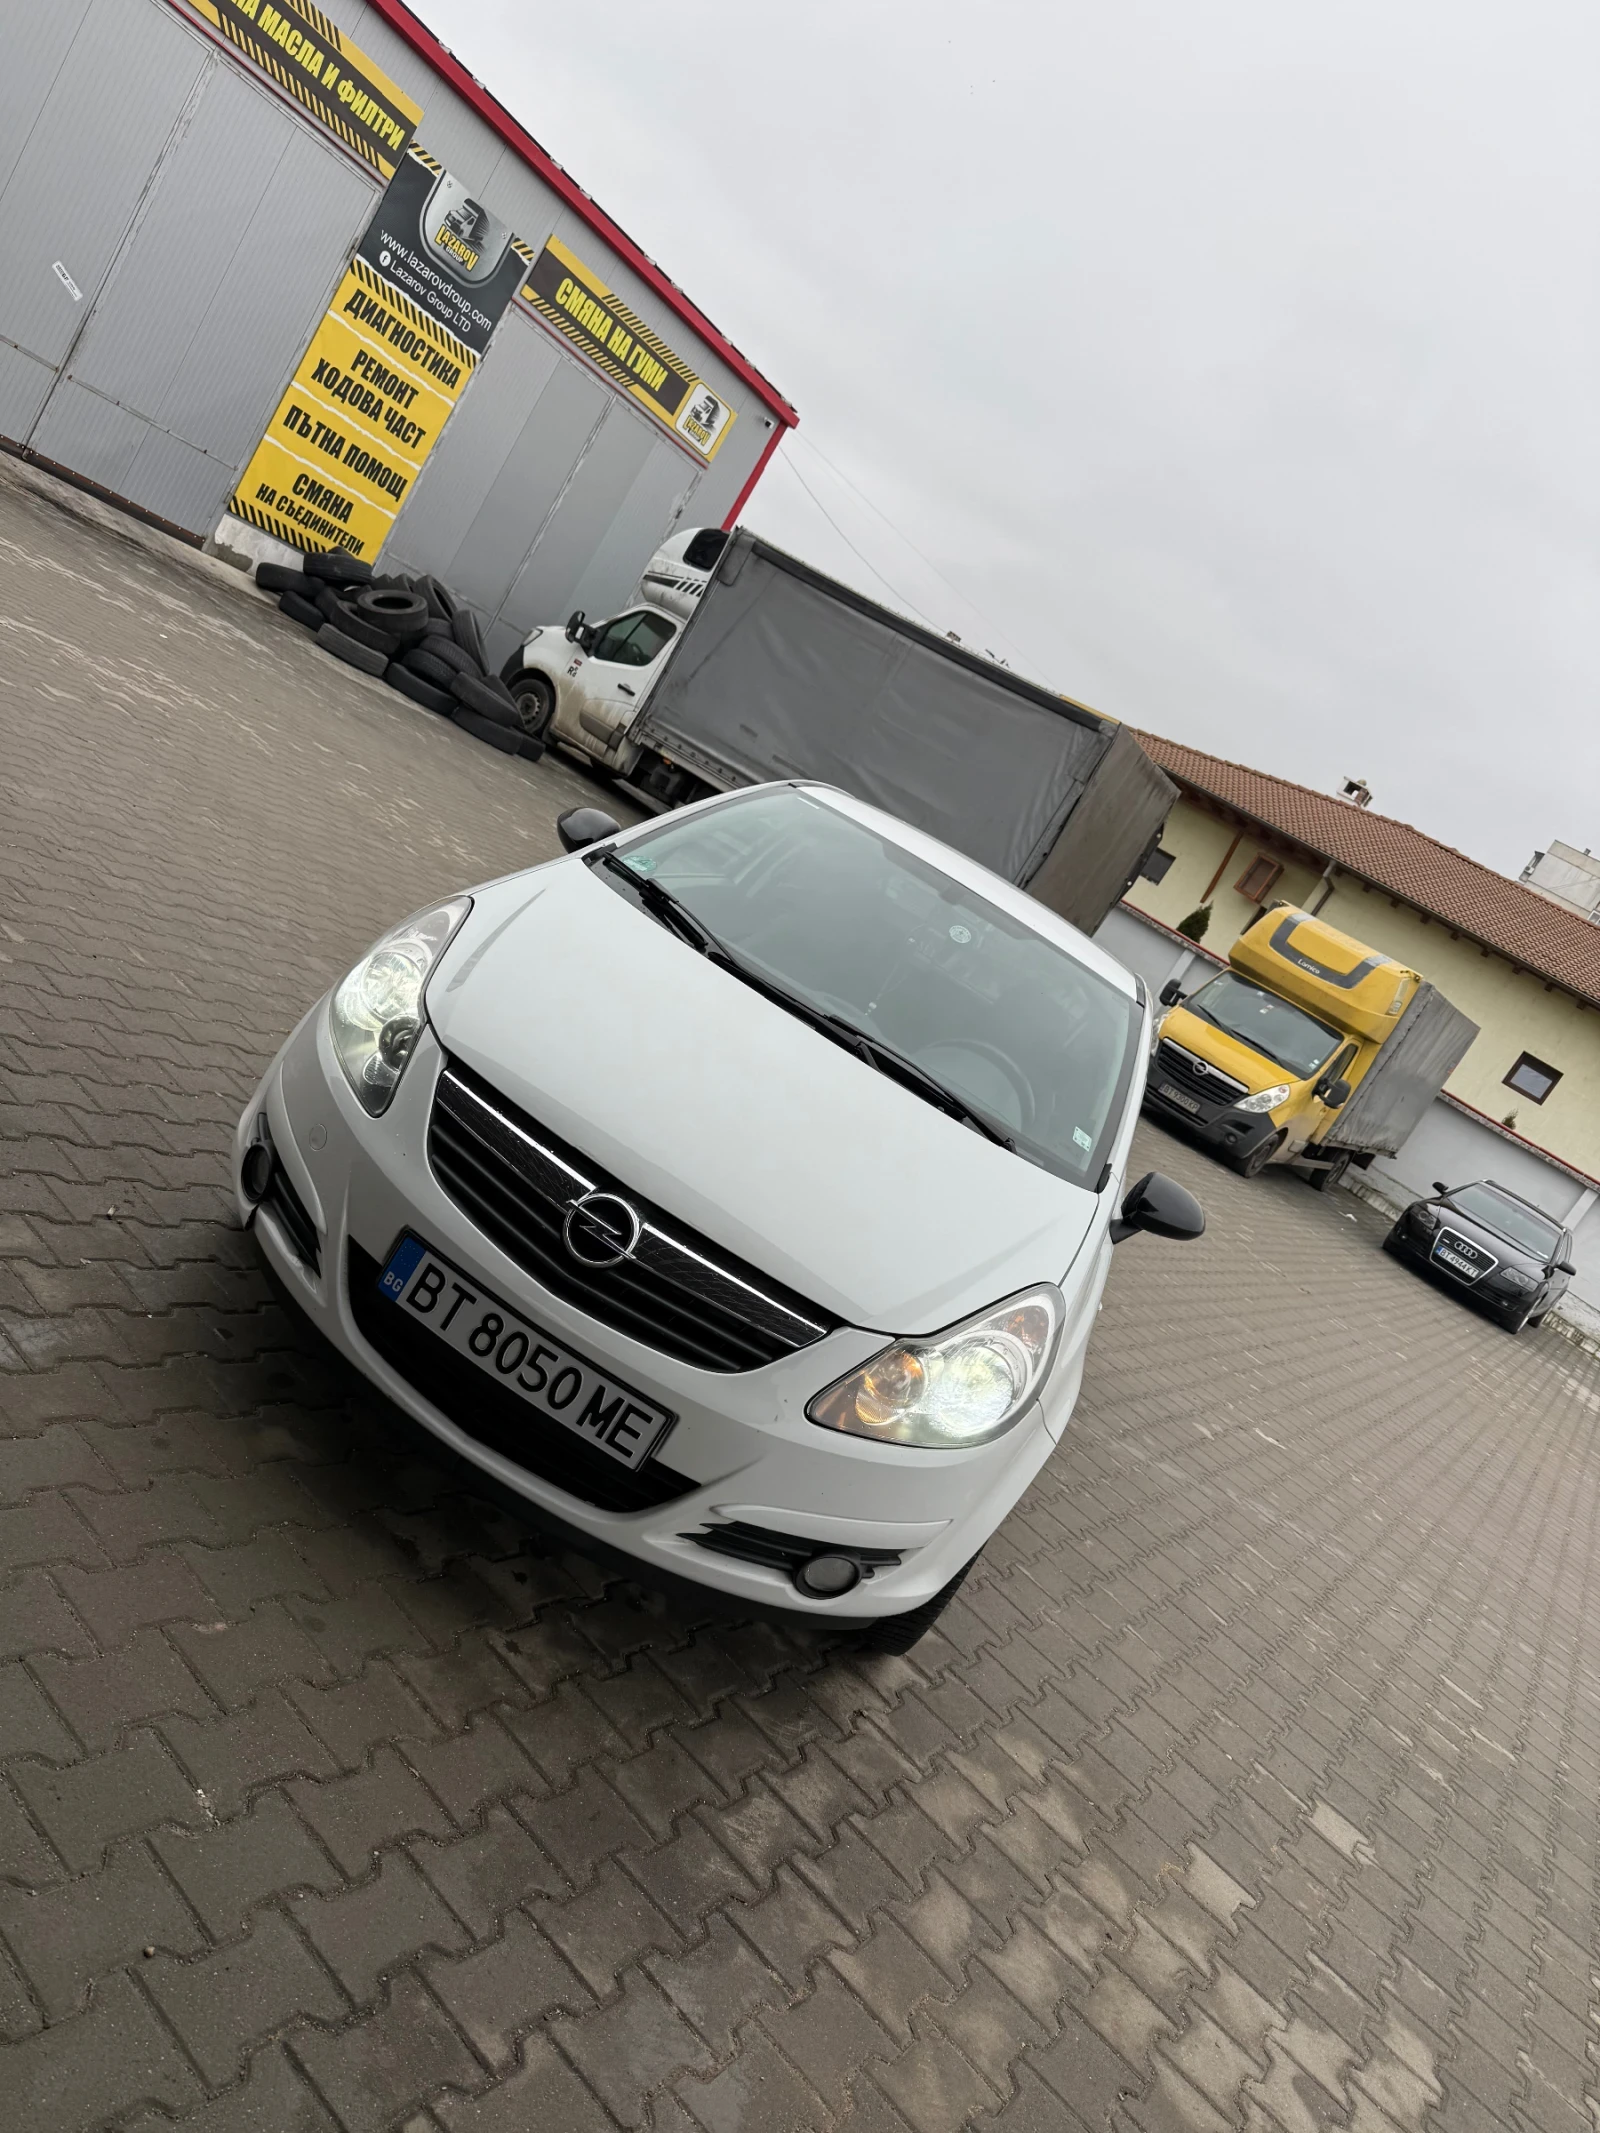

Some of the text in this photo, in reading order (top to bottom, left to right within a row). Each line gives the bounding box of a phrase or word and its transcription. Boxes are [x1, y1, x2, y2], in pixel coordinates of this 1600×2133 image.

[257, 3, 325, 79] МАСЛА
[320, 62, 340, 90] И
[337, 79, 406, 150] ФИЛТРИ
[380, 229, 492, 331] www.lazarovdroup.com
[434, 224, 480, 272] LAZAROV
[390, 260, 471, 332] Lazarov Group LTD
[555, 278, 668, 392] СМЯНА НА ГУМИ
[344, 288, 461, 389] ДИАГНОСТИКА
[350, 349, 419, 409] РЕМОНТ
[311, 358, 426, 449] ХОДОВА ЧАСТ
[283, 405, 408, 502] ПЪТНА ПОМОЩ
[255, 483, 365, 556] НА СЪЕДИНИТЕЛИ
[291, 473, 355, 524] СМЯНА
[383, 1271, 403, 1292] BG
[1440, 1249, 1451, 1259] BT
[405, 1263, 654, 1459] BT 8050 ME
